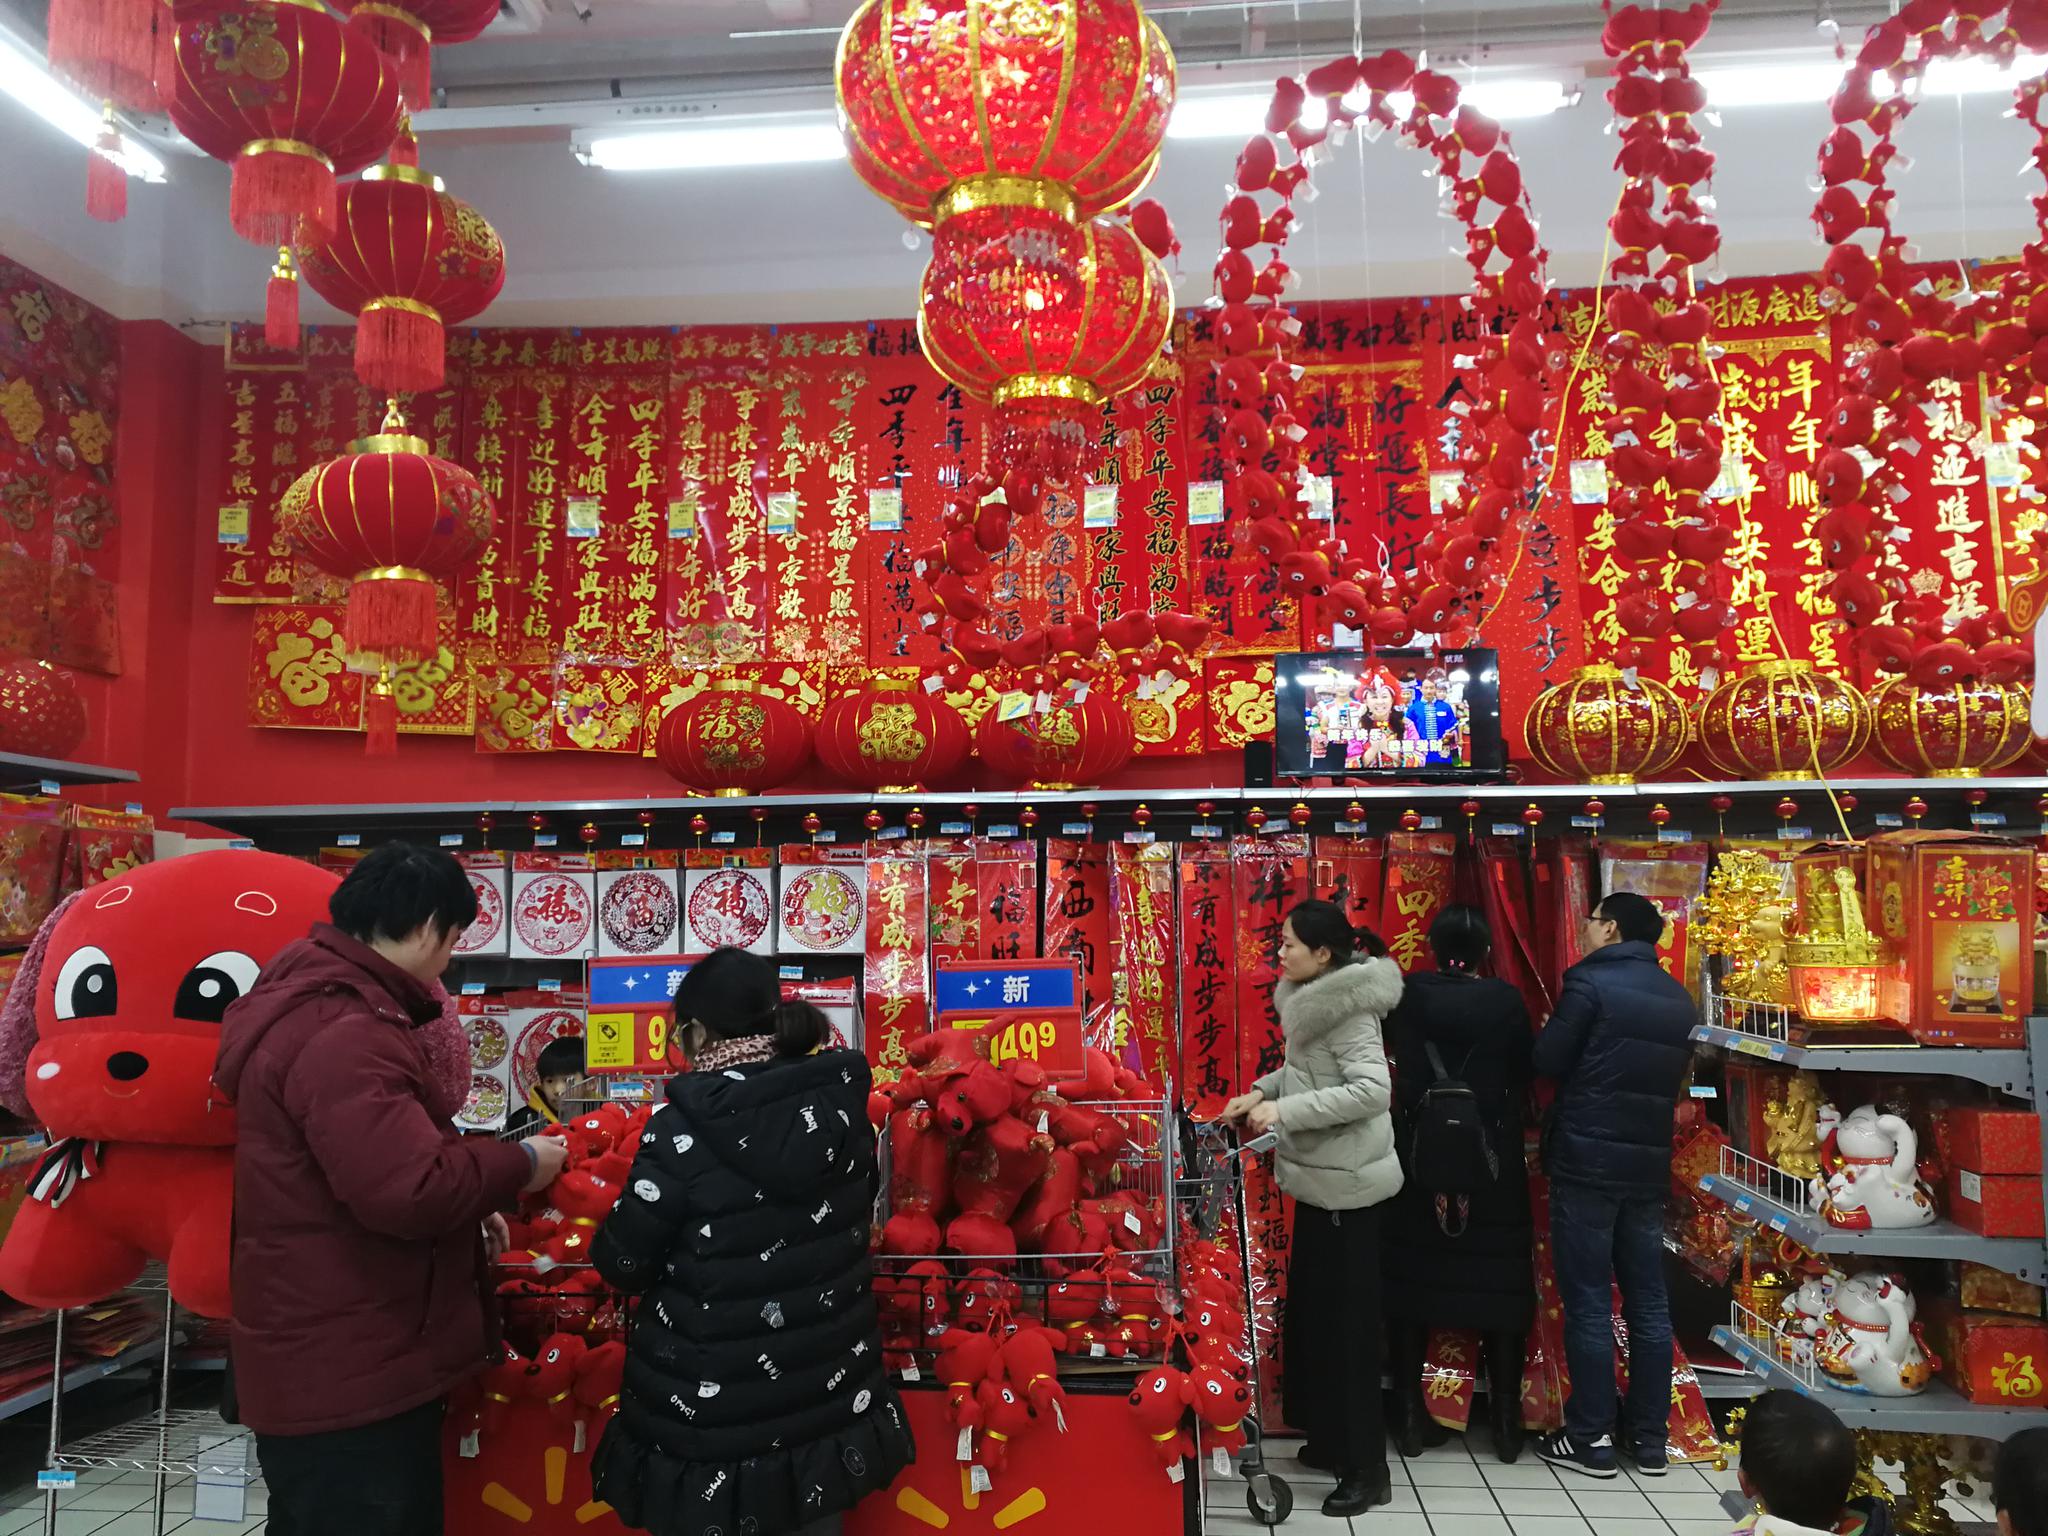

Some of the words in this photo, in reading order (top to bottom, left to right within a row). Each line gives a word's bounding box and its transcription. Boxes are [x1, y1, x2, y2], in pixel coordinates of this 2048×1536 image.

[573, 393, 609, 632] 全年順家興旺
[1094, 398, 1128, 625] 全年順家興旺
[535, 883, 581, 927] 福
[713, 878, 748, 921] 福
[1389, 889, 1437, 972] 四季
[1002, 975, 1031, 1004] 新
[1991, 1352, 2043, 1398] 福
[670, 1394, 697, 1420] OMG!
